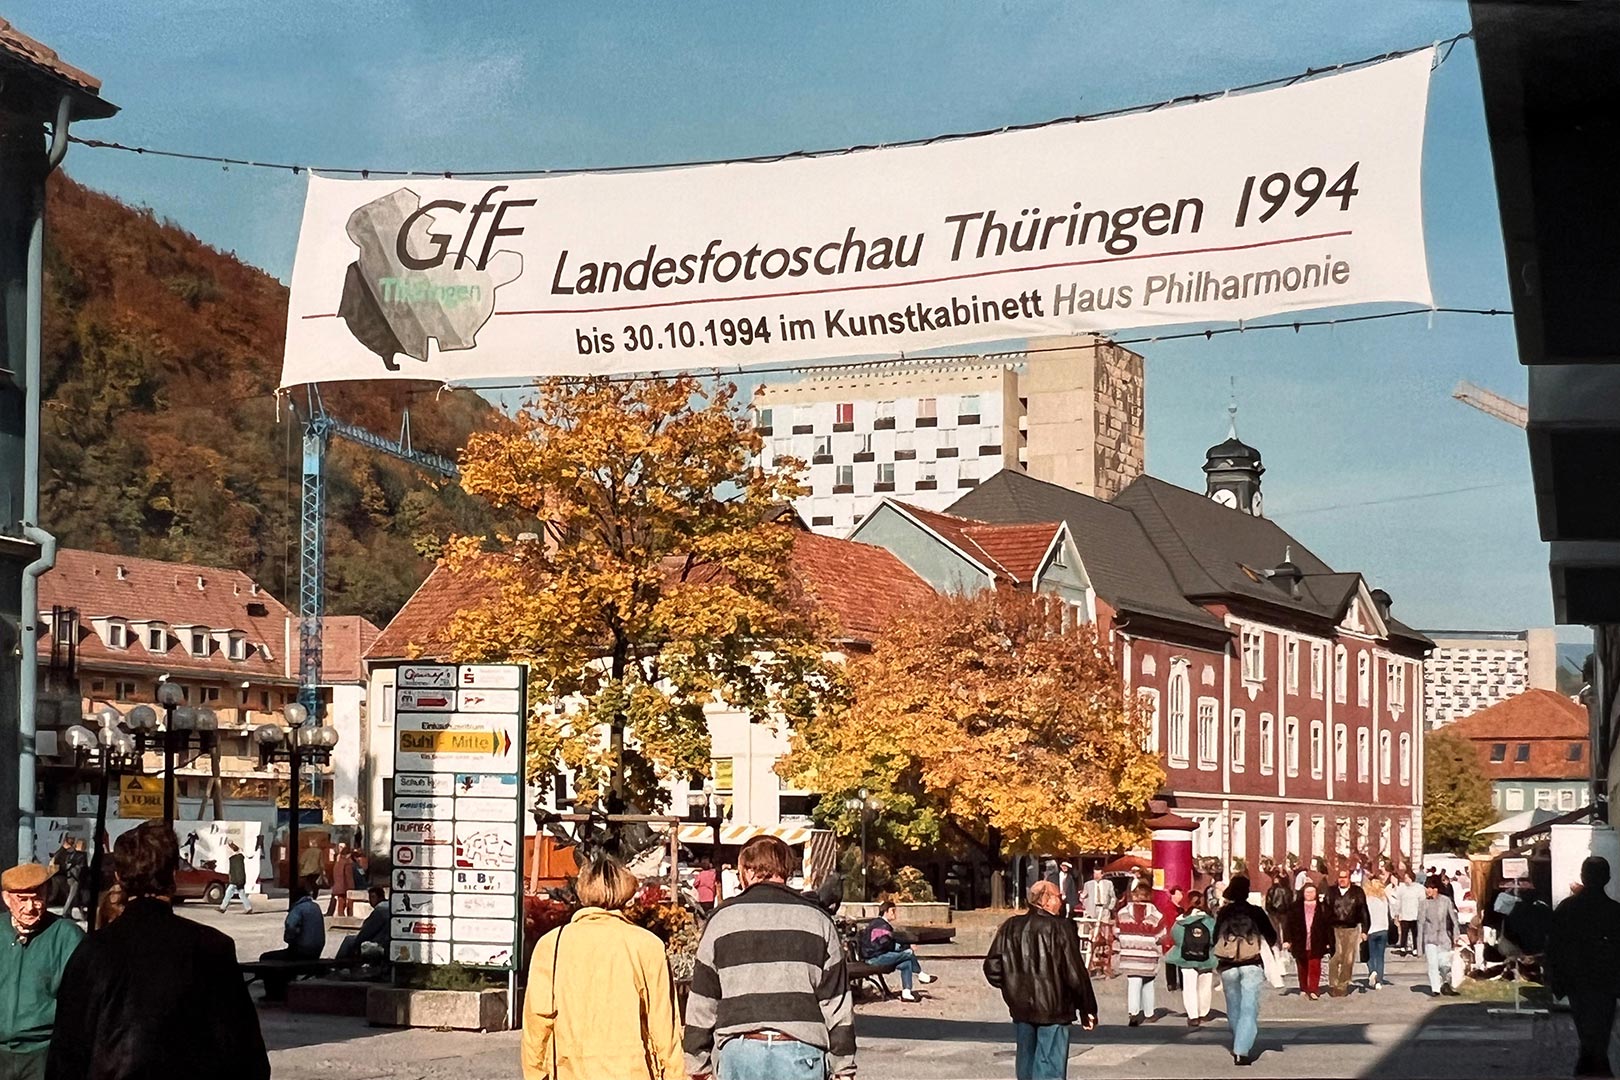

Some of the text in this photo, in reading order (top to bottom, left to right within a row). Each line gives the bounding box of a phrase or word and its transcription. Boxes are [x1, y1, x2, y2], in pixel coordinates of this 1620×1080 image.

[395, 185, 538, 271] GfF
[550, 161, 1360, 295] Landesfotoschau Thüringen 1994
[575, 254, 1351, 355] bis 30.10.1994 im Kunstkabinett Haus Philharmonie
[401, 733, 434, 749] Suhl
[452, 735, 489, 749] Mitte
